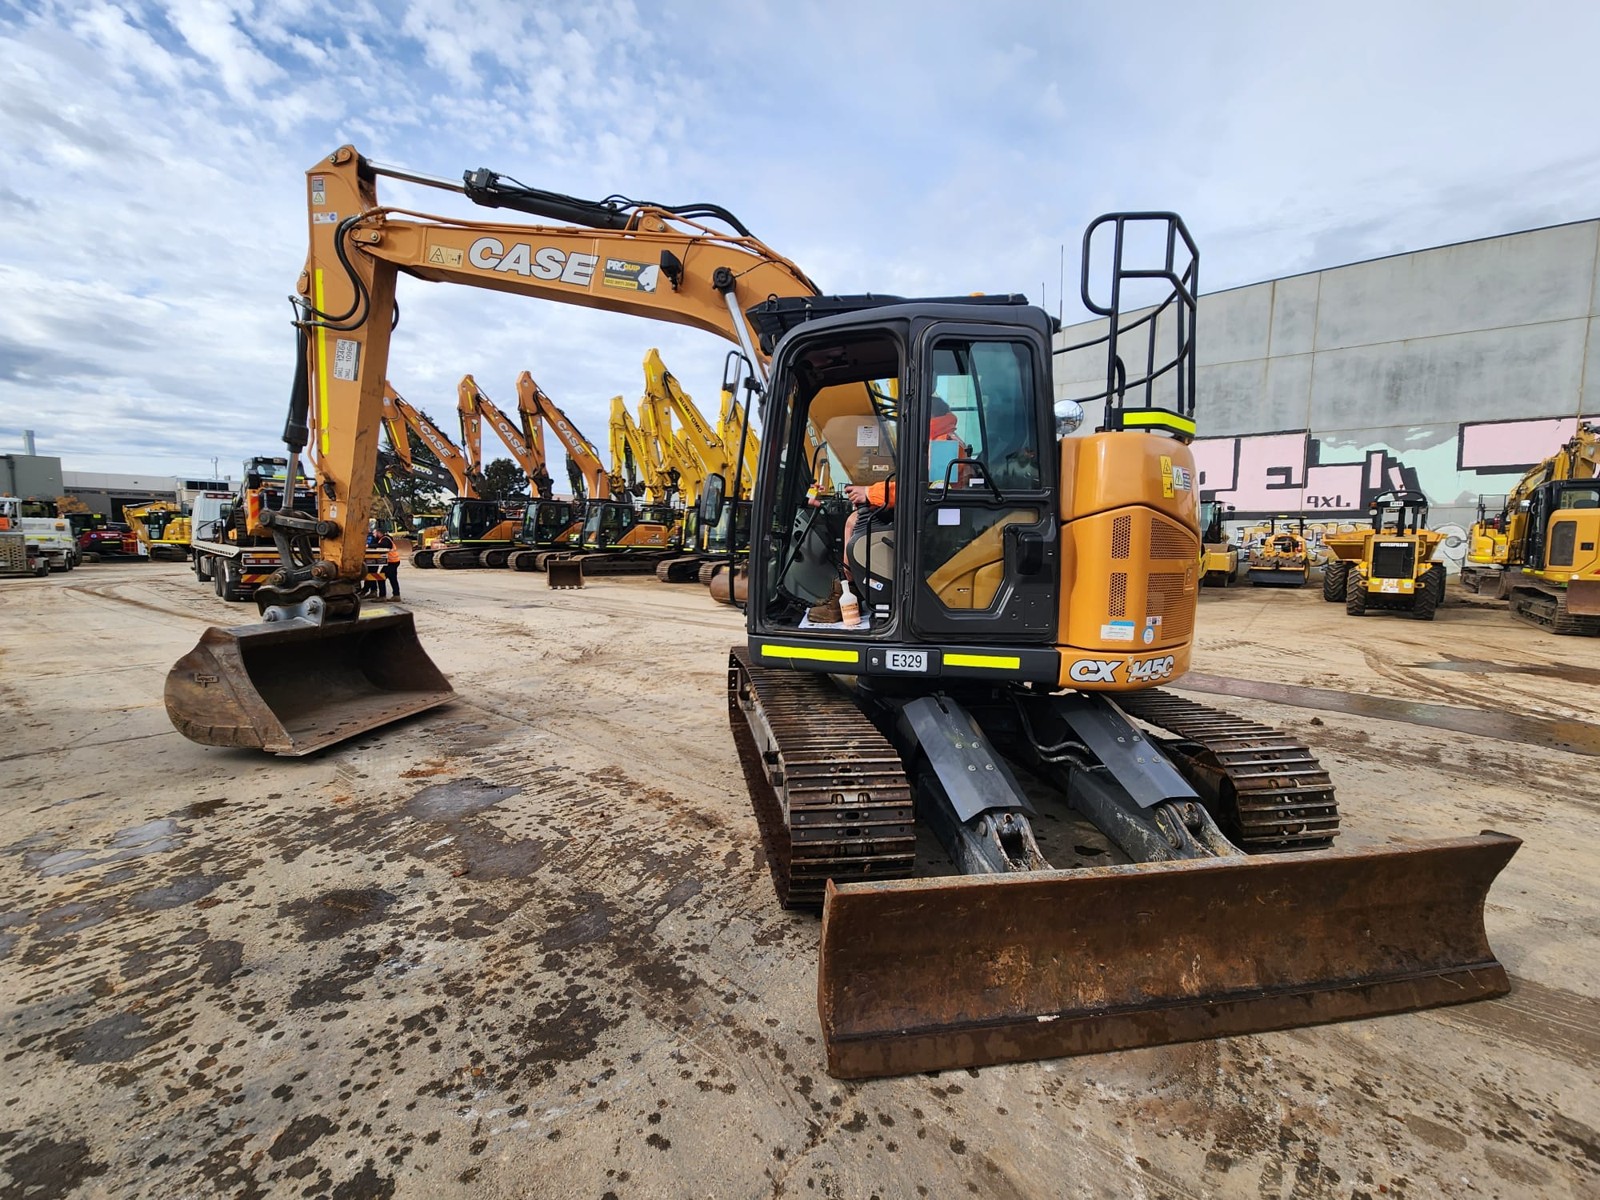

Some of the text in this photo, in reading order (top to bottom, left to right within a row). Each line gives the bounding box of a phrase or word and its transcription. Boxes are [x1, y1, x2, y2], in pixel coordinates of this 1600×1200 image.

[468, 236, 600, 287] CASE
[606, 259, 641, 272] PROQUIP
[678, 396, 703, 434] SUMITOMO
[420, 424, 452, 457] CASE
[498, 422, 527, 456] CASE
[557, 420, 584, 455] CASE
[411, 463, 433, 475] OLVO
[892, 654, 922, 668] E329
[1069, 655, 1175, 684] CX 145C
